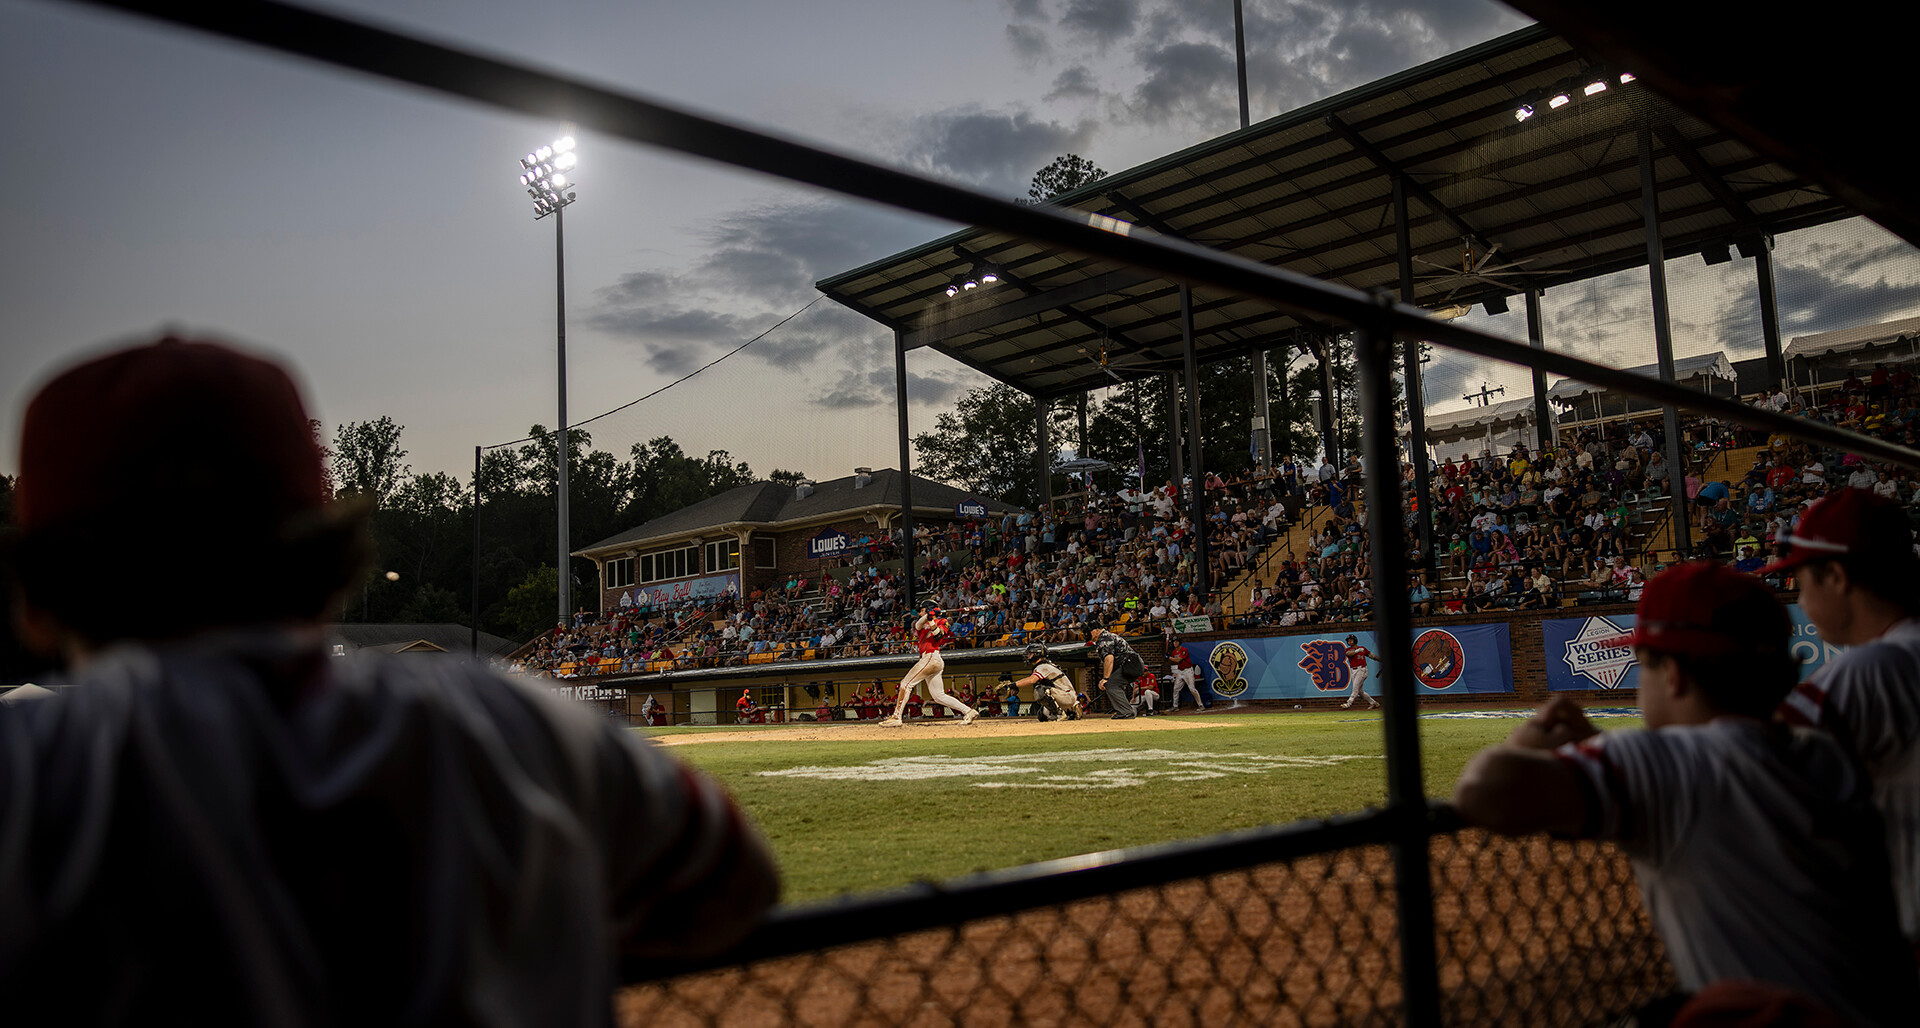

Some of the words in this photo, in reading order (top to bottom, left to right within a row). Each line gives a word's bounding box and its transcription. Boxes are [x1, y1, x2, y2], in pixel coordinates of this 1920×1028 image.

[959, 503, 985, 516] LOWE'S
[812, 533, 846, 554] LOWE'S
[653, 588, 670, 606] Play
[1586, 628, 1610, 637] LEGION
[1577, 645, 1631, 665] SERIES
